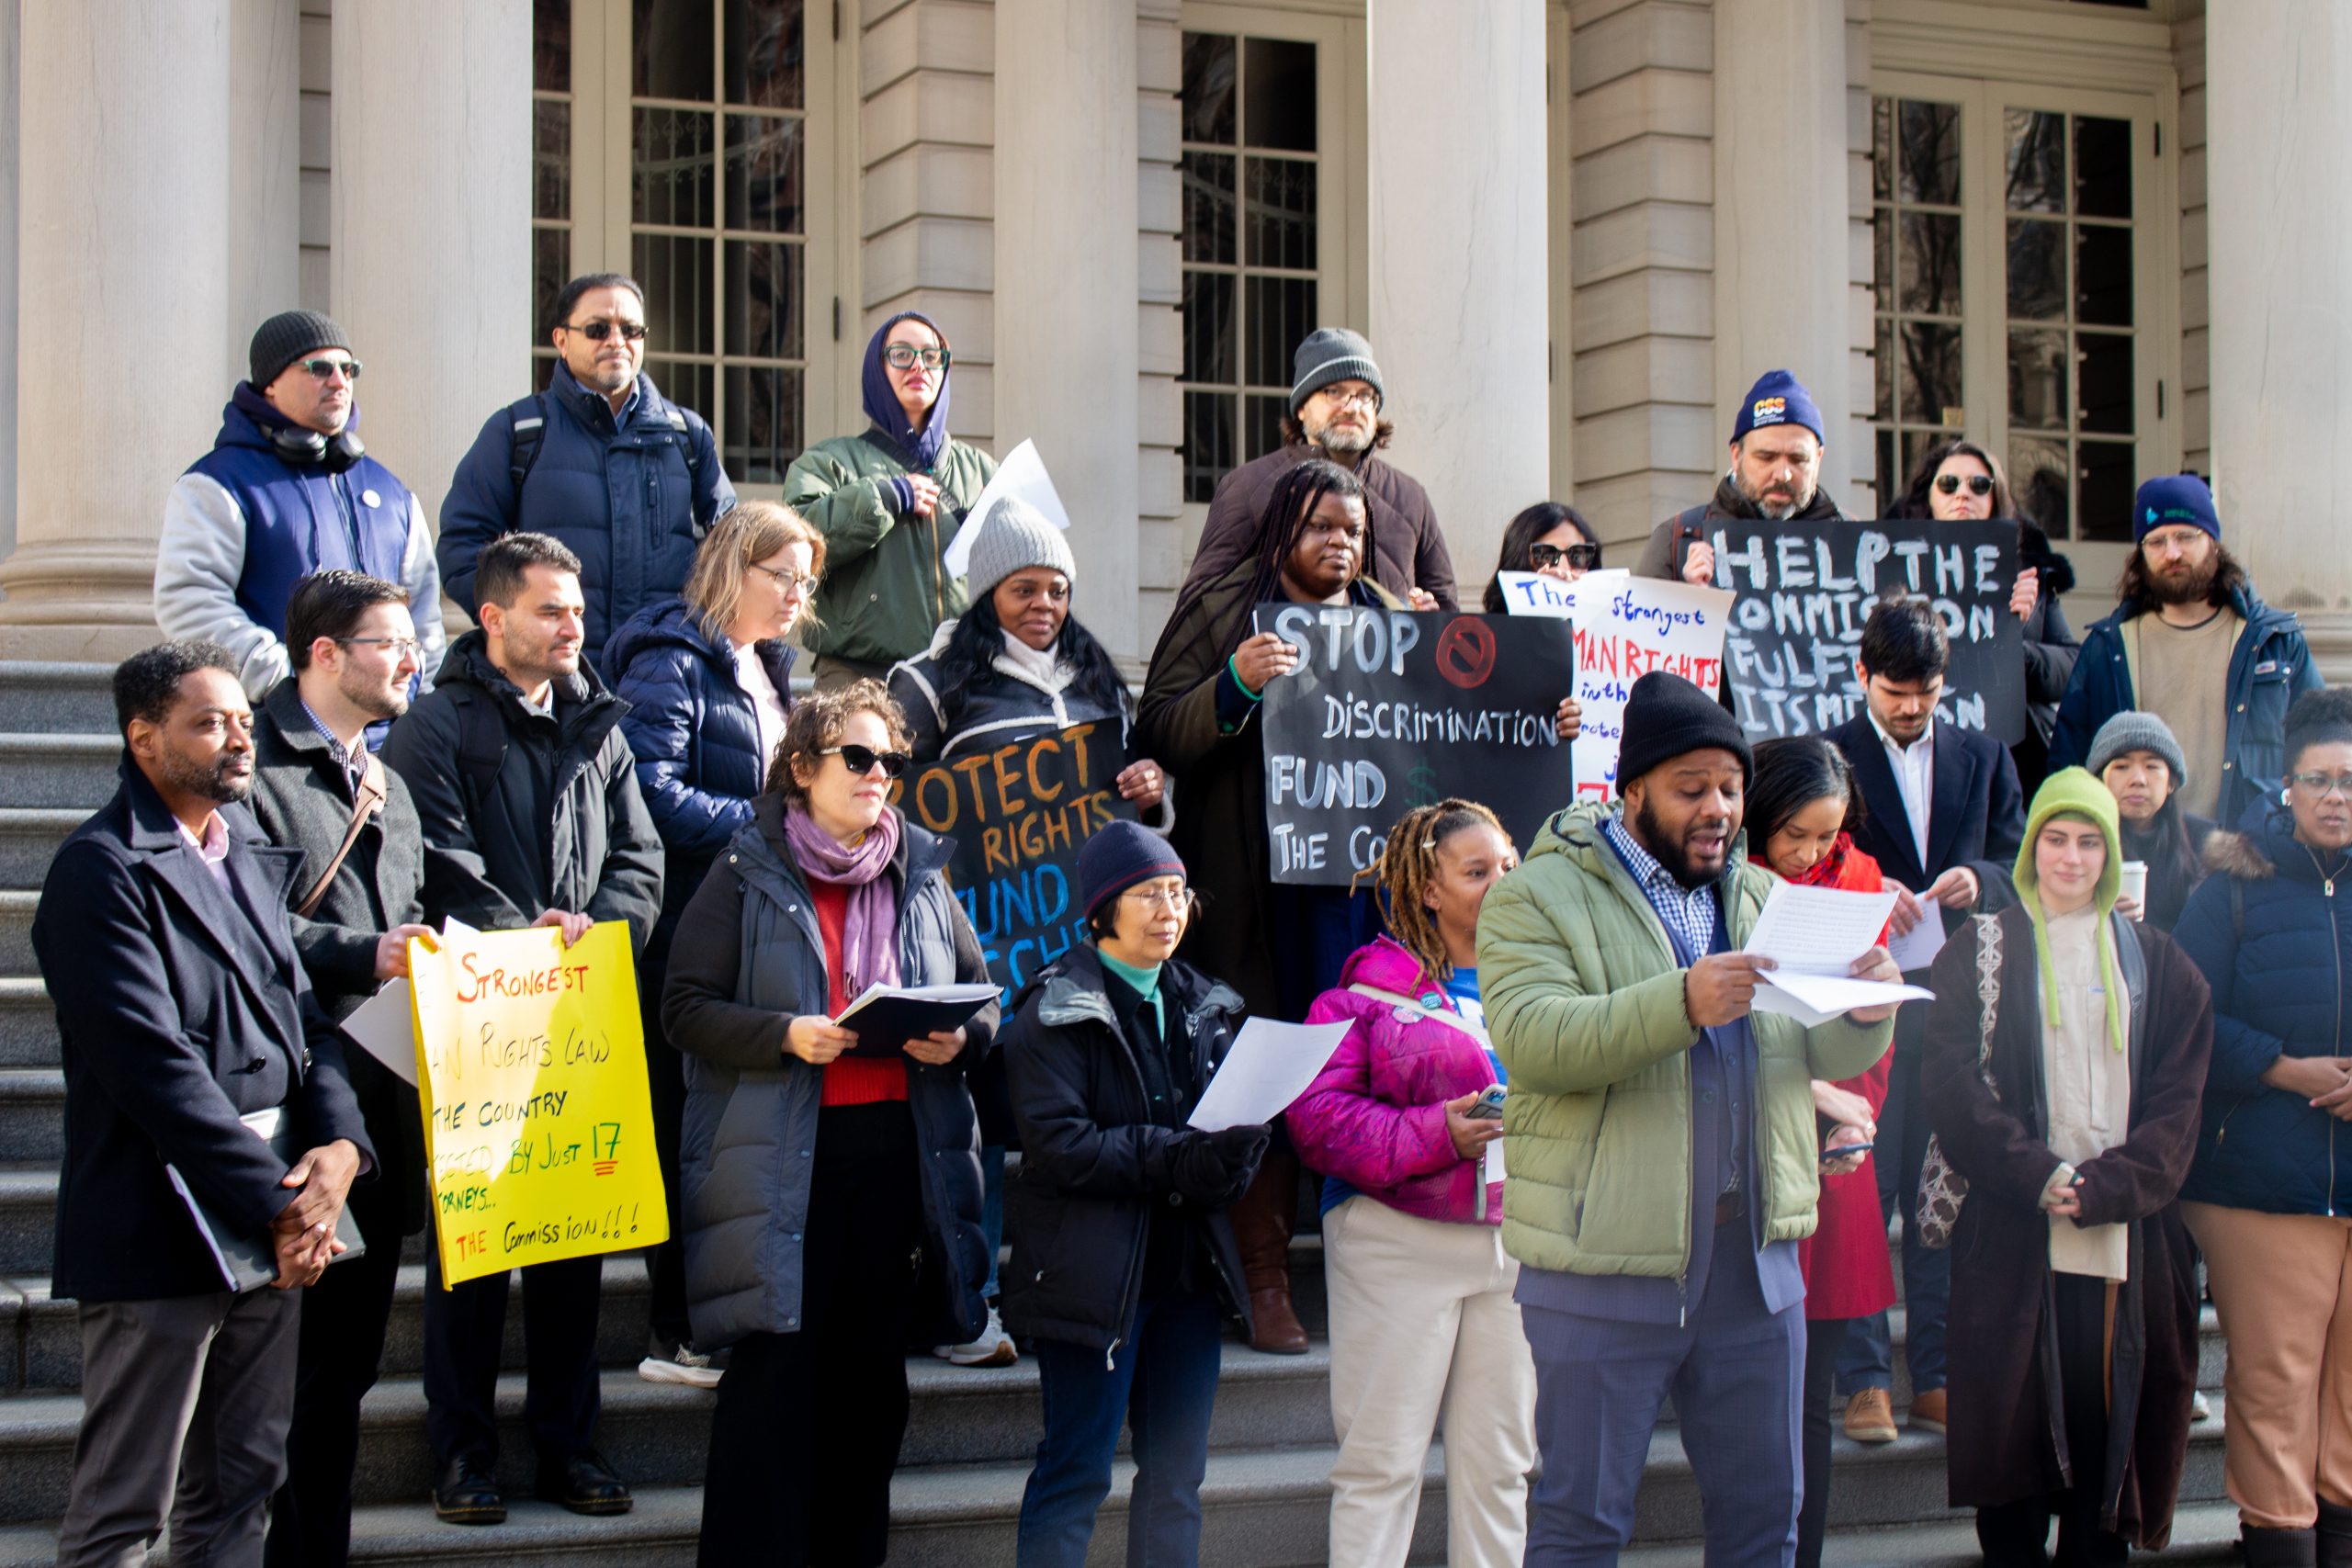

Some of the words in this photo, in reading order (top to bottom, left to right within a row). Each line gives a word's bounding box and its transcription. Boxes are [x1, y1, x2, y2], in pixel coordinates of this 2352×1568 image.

[1713, 529, 1890, 594] HELP
[1894, 538, 2000, 595] THE
[1516, 580, 1576, 607] The
[1274, 605, 1421, 677] STOP
[1625, 639, 1720, 689] RIGHTS
[1733, 682, 1810, 738] ITS
[888, 723, 1095, 832] OTECT
[1271, 754, 1386, 809] FUND
[982, 790, 1114, 874] RIGHTS
[1272, 822, 1329, 875] THE
[955, 863, 1069, 946] UND
[457, 952, 589, 1003] STRONGEST
[480, 1021, 552, 1069] RIGHTS
[479, 1089, 568, 1128] COUNTRY
[508, 1137, 534, 1175] BY
[593, 1122, 622, 1161] 17
[438, 1185, 497, 1215] ORNEYS...
[456, 1229, 488, 1262] THE
